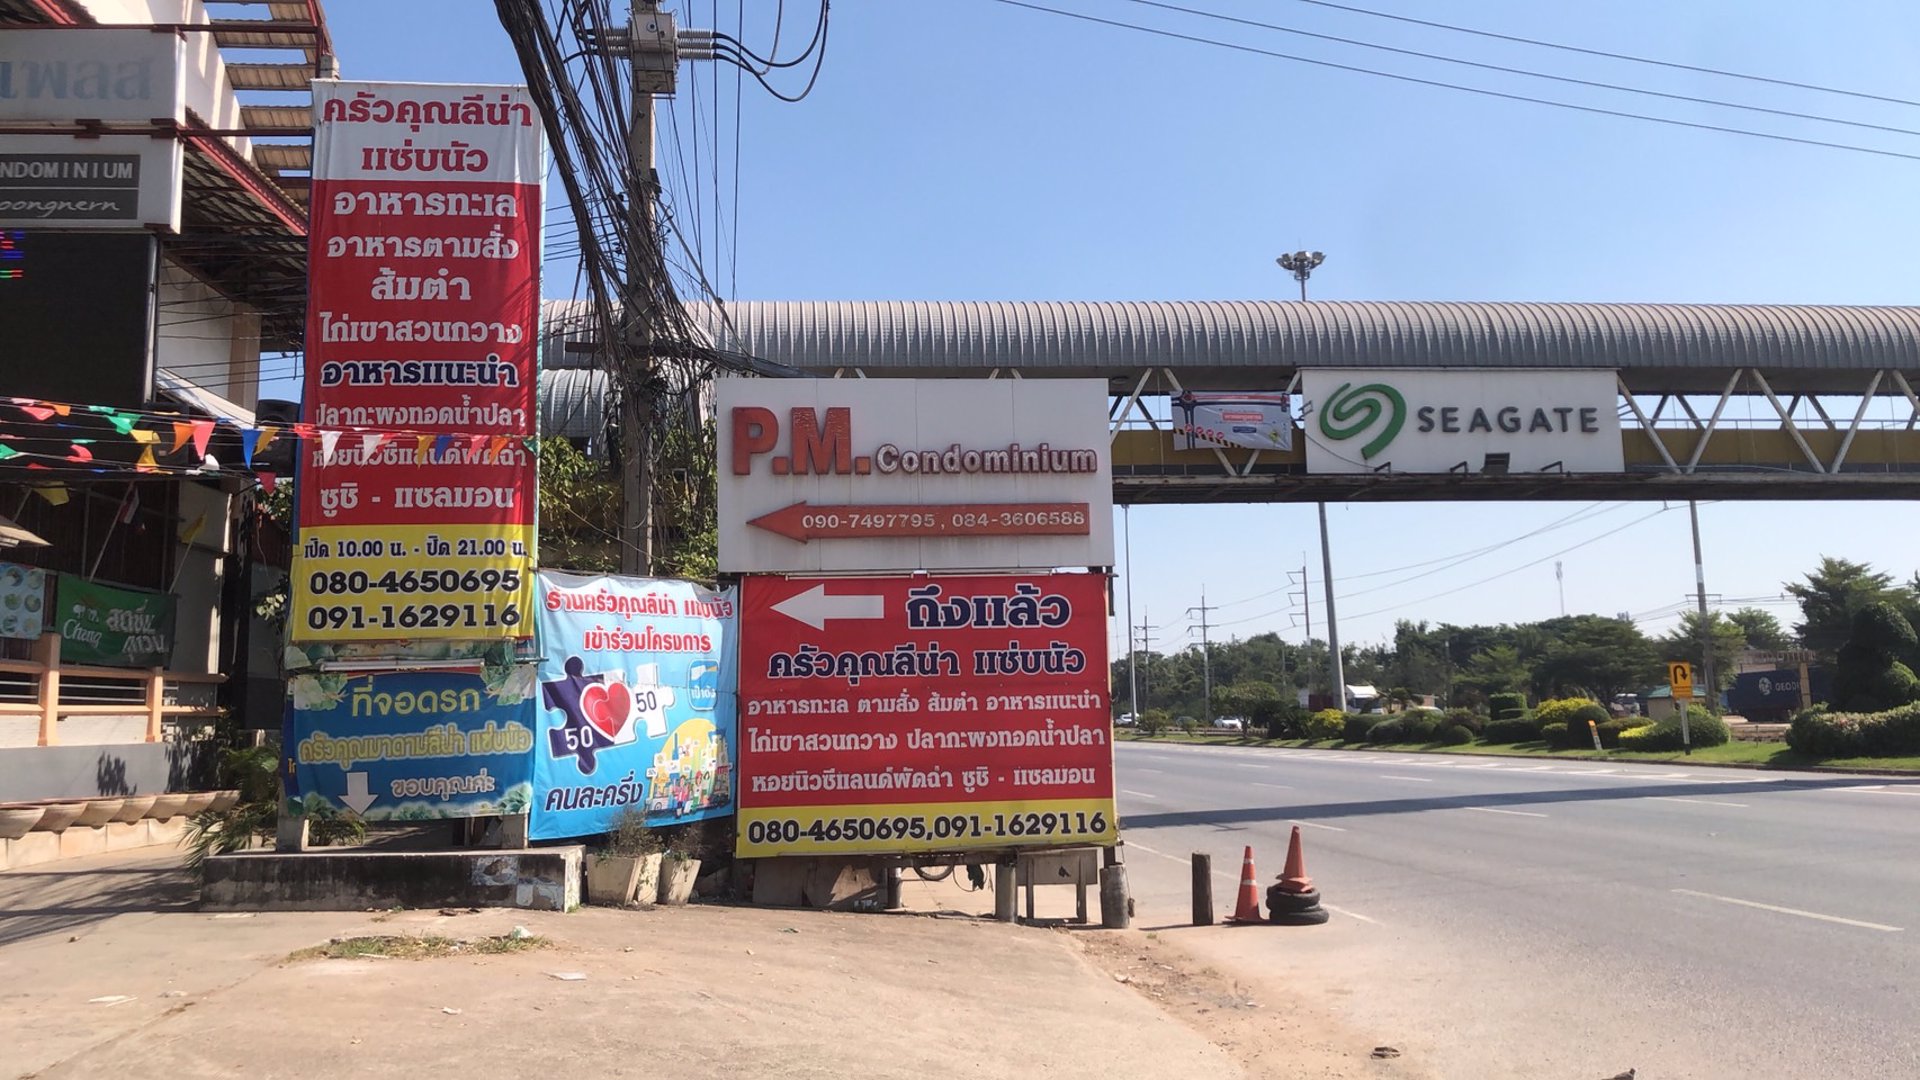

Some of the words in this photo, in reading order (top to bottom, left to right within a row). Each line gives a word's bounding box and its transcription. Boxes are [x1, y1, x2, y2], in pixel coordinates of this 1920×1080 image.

[324, 91, 532, 133] ครัวคุณลีน่า
[361, 139, 489, 172] แซ่บนัว
[334, 190, 518, 218] อาหารทะเล
[327, 224, 520, 260] อาหารตามสั่ง
[370, 267, 472, 301] ส้มตำ
[319, 311, 523, 344] ไก่เขาสวนกวาง
[320, 353, 520, 388] อาหารแนะนำ
[316, 395, 526, 427] ปลากะพงทอดน้ำปลา
[1417, 406, 1600, 433] SEAGATE
[312, 441, 528, 468] หยนิวซีแลนด์ผดฉ่า
[732, 406, 871, 476] P.M.
[875, 443, 1099, 475] Condominium
[320, 482, 358, 517] ซูชิ
[394, 487, 515, 508] แซลมอน
[952, 511, 1085, 528] 084-3606588
[337, 541, 383, 557] 10.00
[390, 542, 407, 557] น.
[426, 536, 450, 556] ปิด
[458, 539, 505, 556] 21.00
[512, 541, 528, 556] น.
[309, 569, 520, 595] 080-4650695
[308, 604, 520, 631] 091-1629116
[684, 597, 733, 619] แบนัว
[906, 583, 1072, 630] ถึงแล้ว
[584, 625, 712, 652] เข้าร่วมโครงการ
[767, 643, 960, 686] ครัวคุณลีน่า
[973, 641, 1086, 676] แซ่บนัว
[352, 674, 481, 717] ที่จอดรถ
[635, 691, 657, 712] 50
[748, 697, 850, 716] อาหารทะเล
[857, 688, 920, 714] ตามสั่ง
[928, 691, 979, 713] ส้มตำ
[986, 690, 1102, 711] อาหารแนะนำ
[564, 726, 593, 751] 50
[748, 727, 898, 754] ไก่เขาสวนกวาง
[906, 718, 1105, 750] ปลากะพงทอดน้ำปลา
[391, 768, 495, 802] ขอบคุณค่ะ
[545, 770, 643, 811] คนละครึ่ง
[962, 766, 989, 794] ซูชิ
[1013, 766, 1096, 786] แซลมอน
